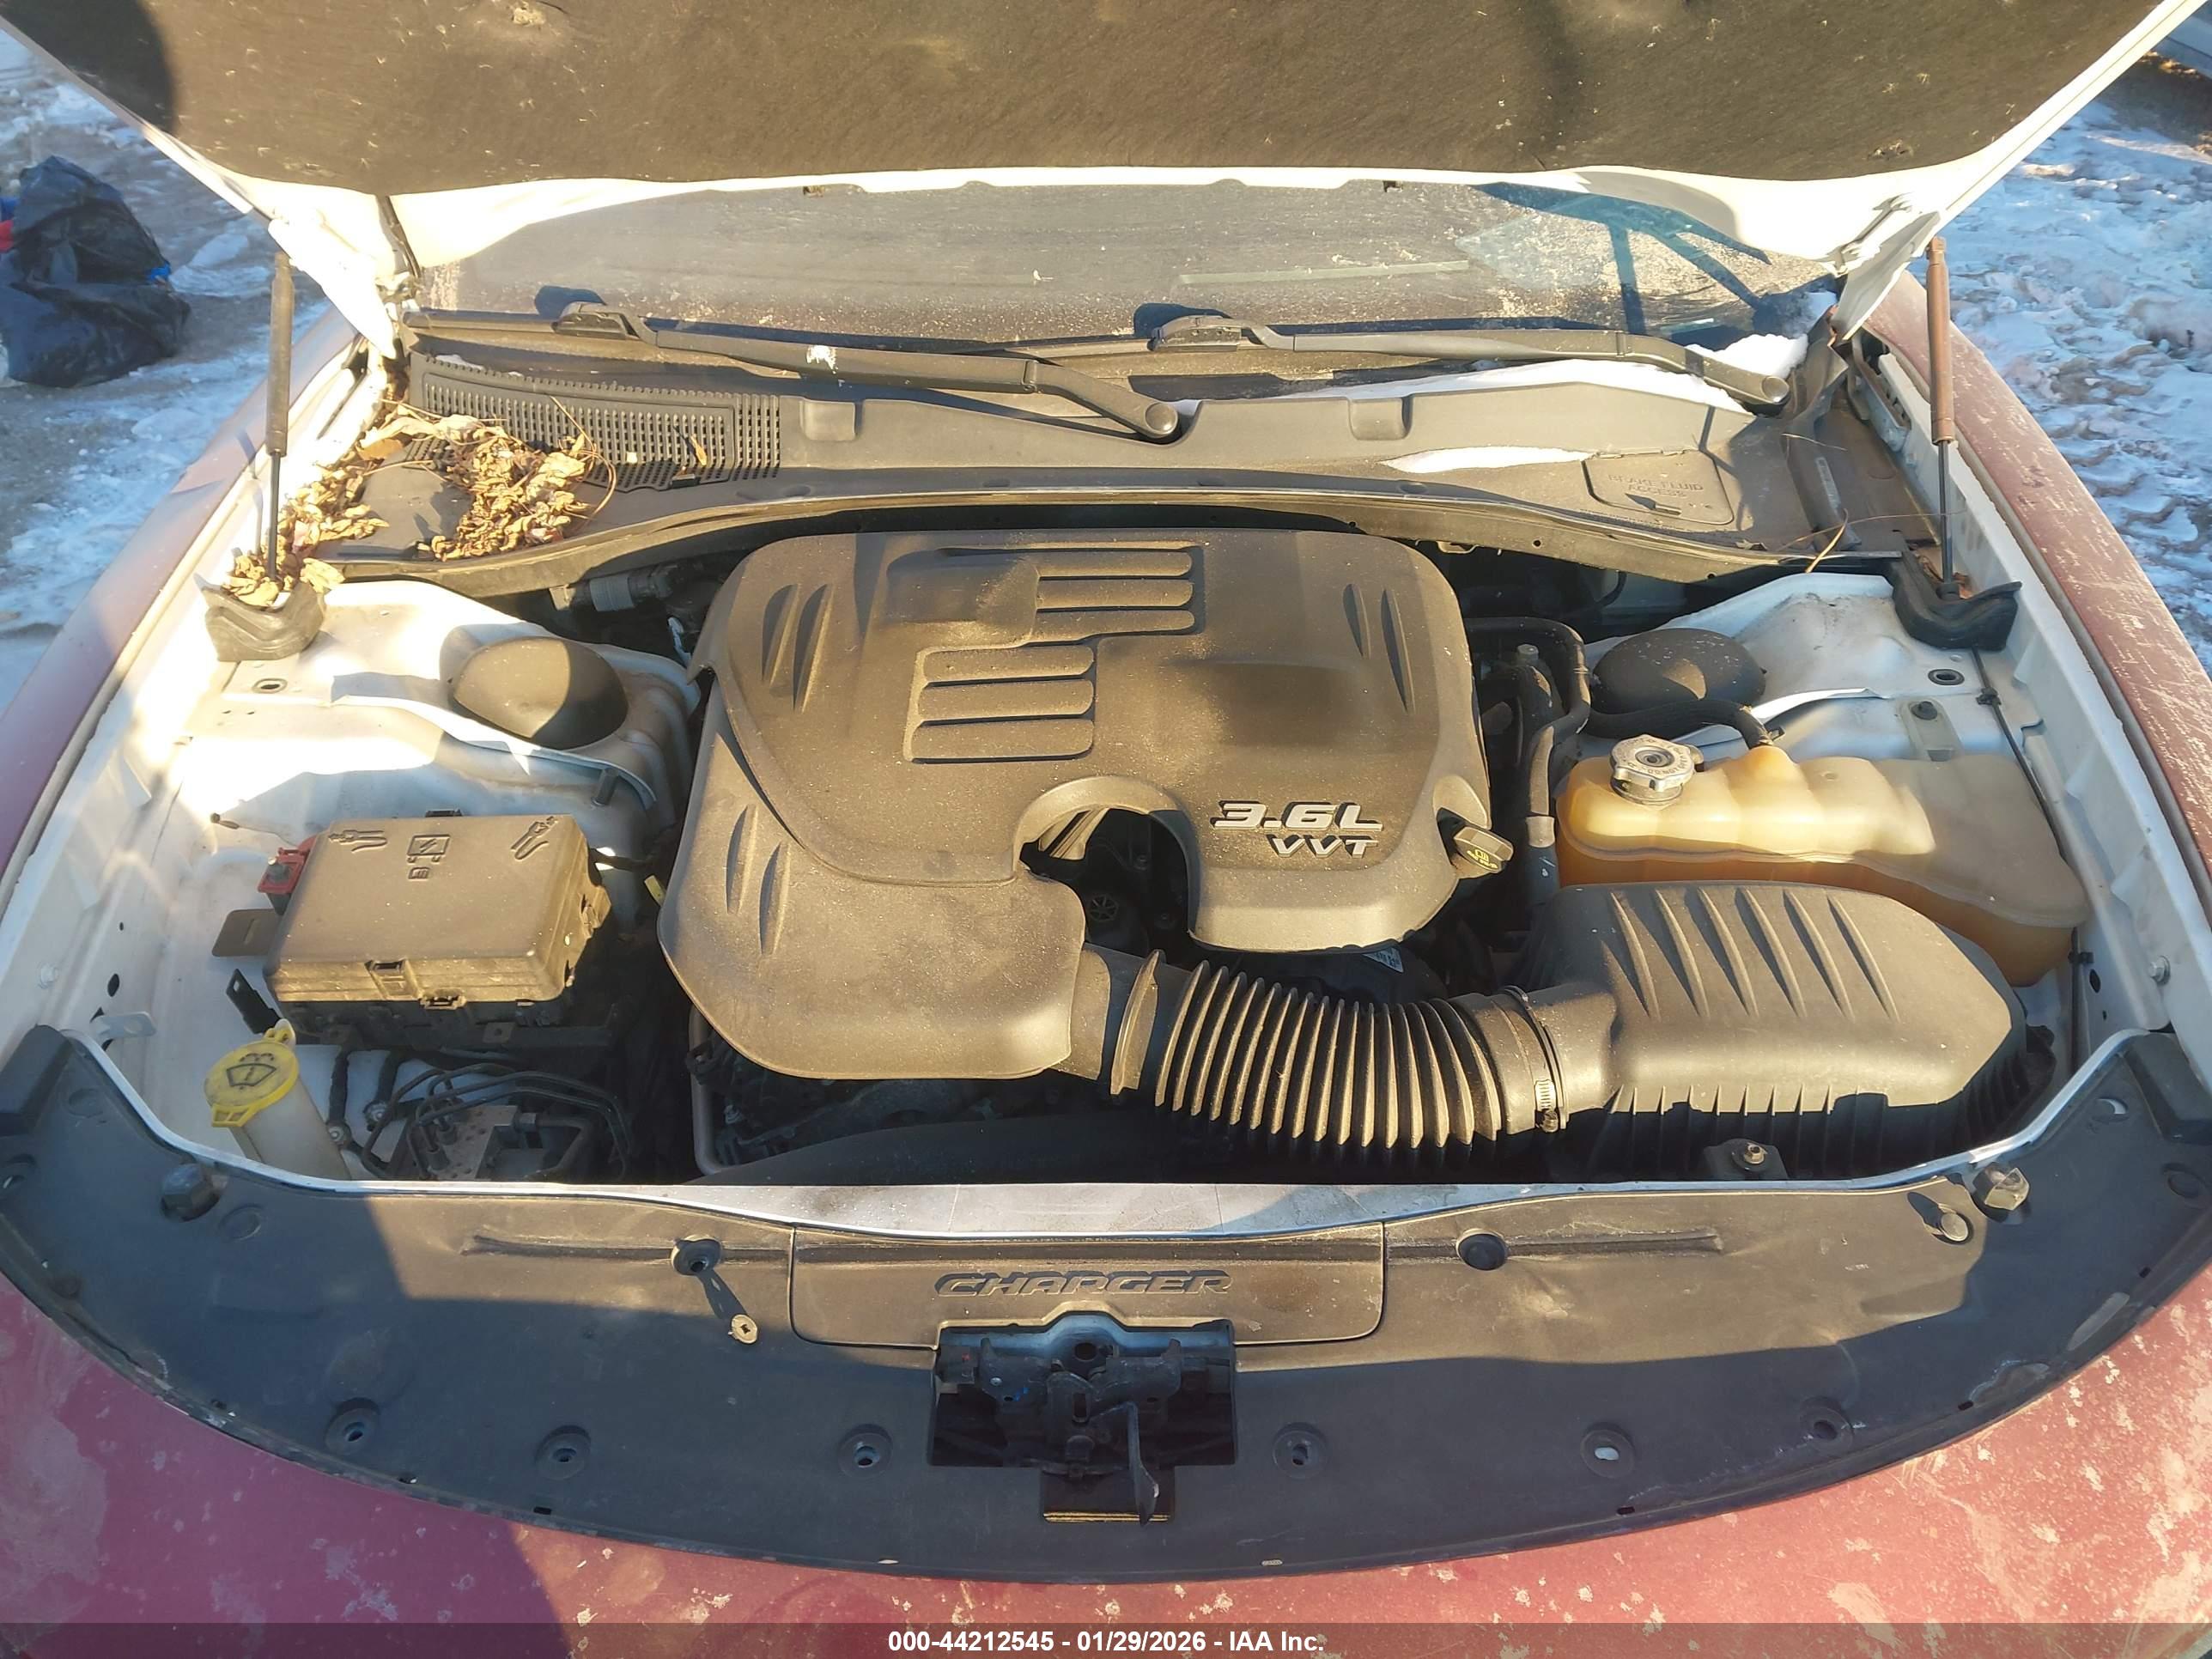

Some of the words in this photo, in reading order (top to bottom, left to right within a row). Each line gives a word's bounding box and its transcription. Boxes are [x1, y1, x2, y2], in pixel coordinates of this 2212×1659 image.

[1608, 474, 1656, 487] BRAKE
[1661, 480, 1704, 490] FLUID
[1628, 483, 1687, 497] ACCESS
[1212, 802, 1383, 831] 3.6L
[1269, 835, 1379, 859] VVT
[935, 1271, 1232, 1297] CHARGER
